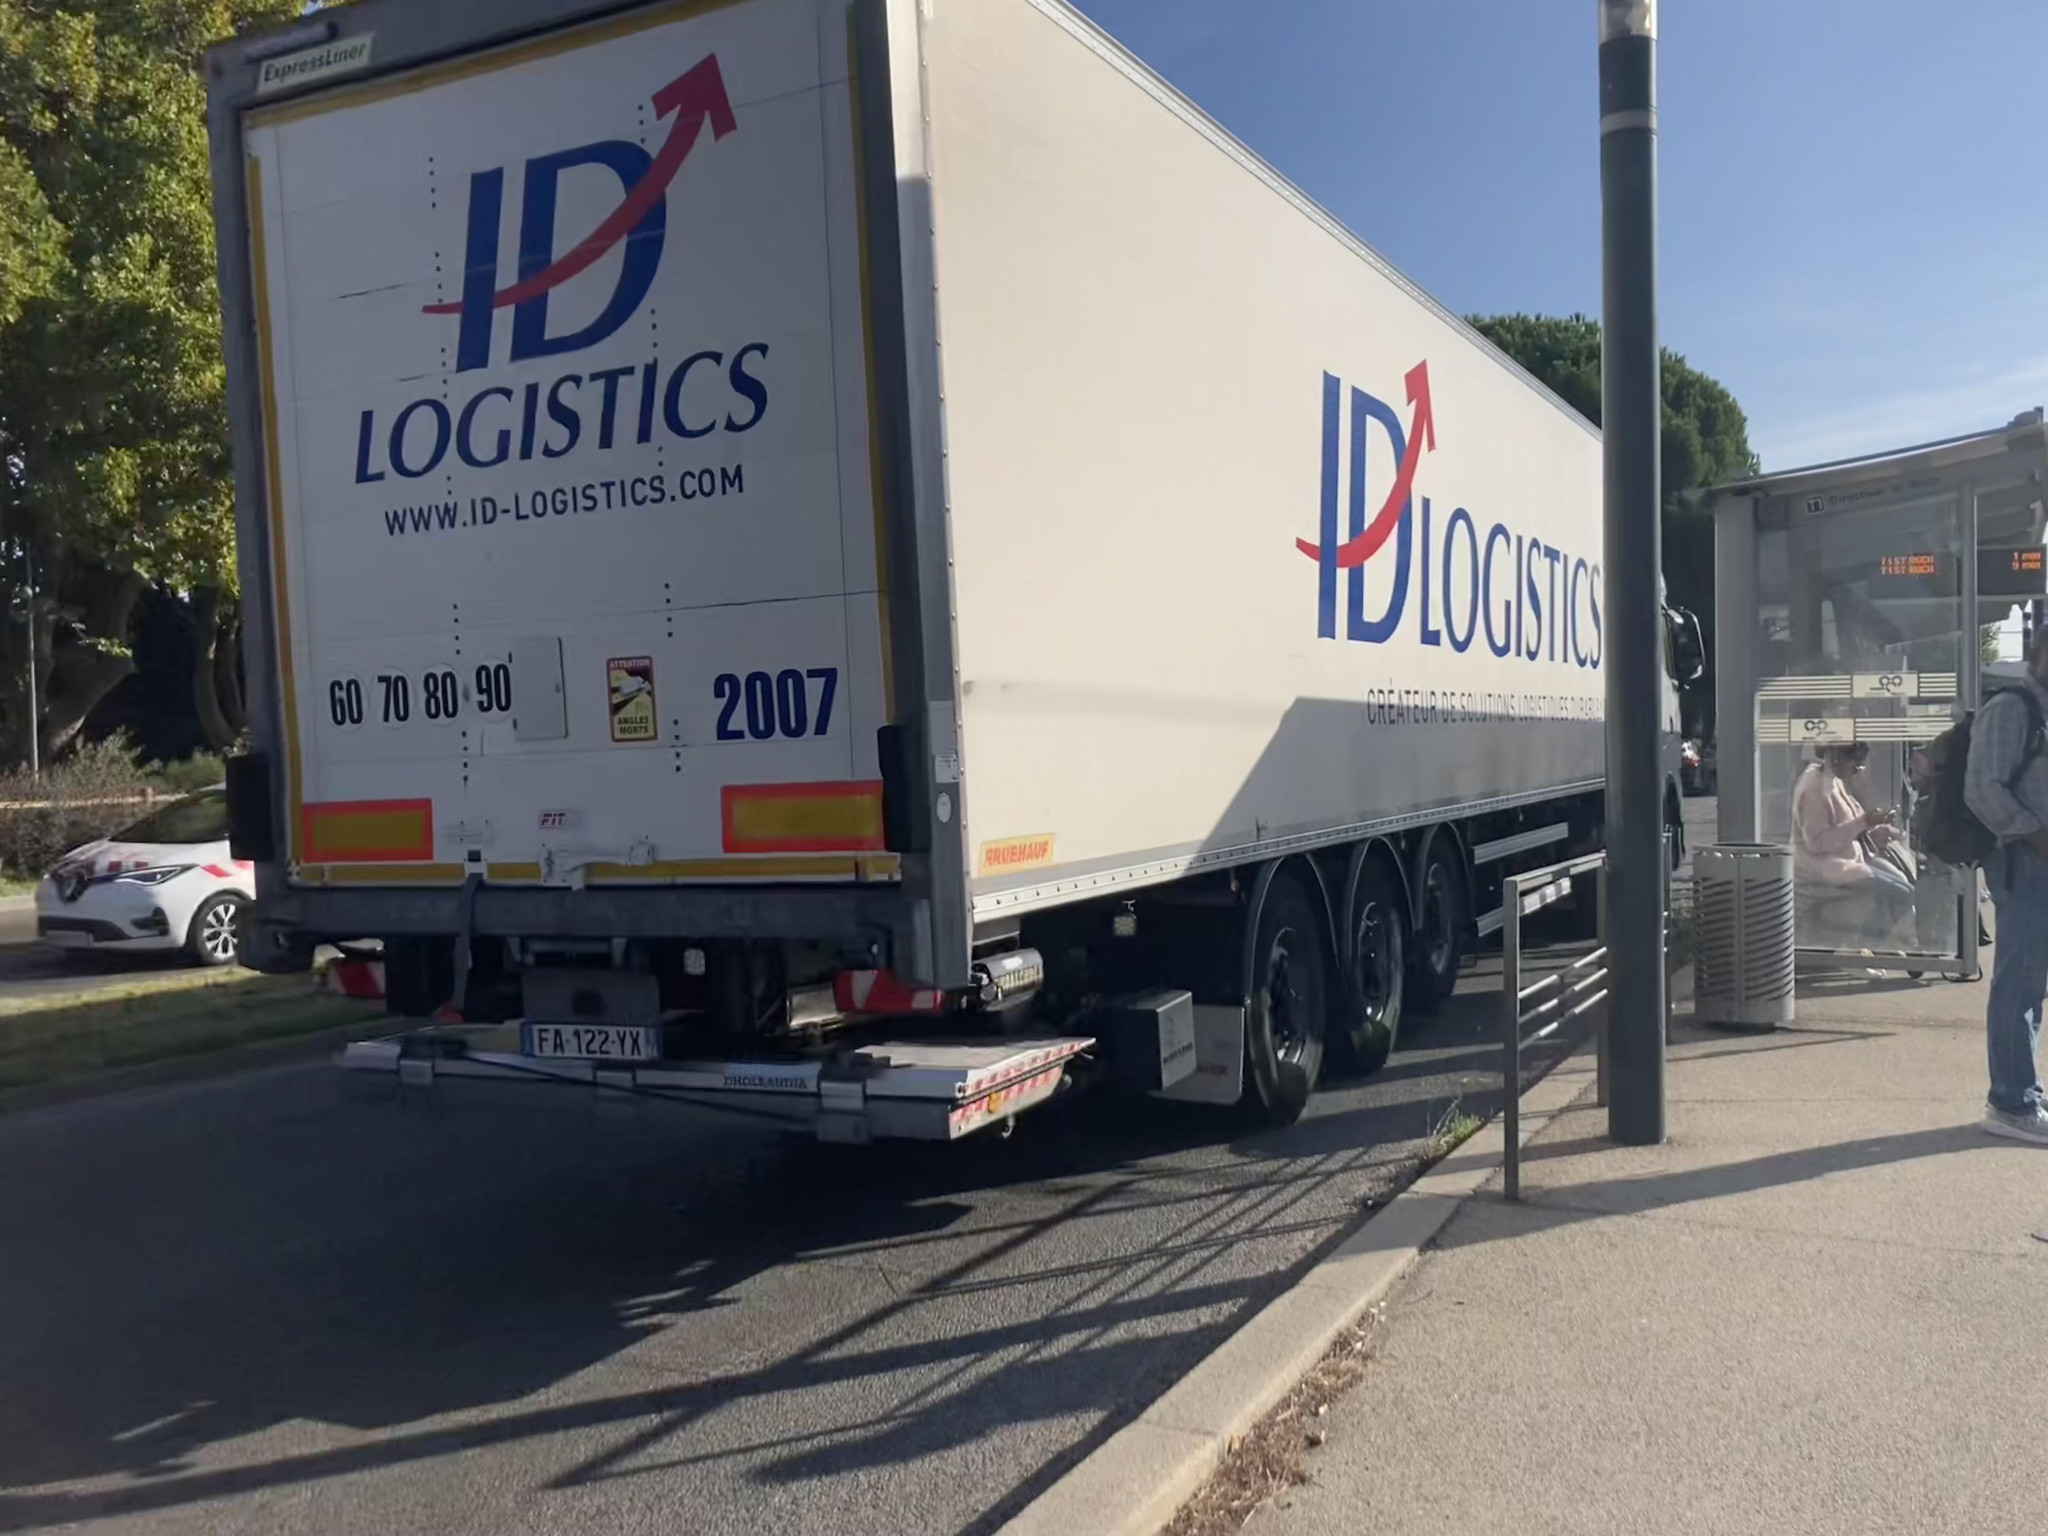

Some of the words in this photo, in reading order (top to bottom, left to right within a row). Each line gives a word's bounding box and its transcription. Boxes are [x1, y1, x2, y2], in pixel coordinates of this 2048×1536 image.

[264, 43, 366, 82] ExpressLiner
[456, 140, 666, 373] ID
[355, 343, 769, 484] LOGISTICS
[384, 464, 745, 535] WWW.ID-LOGISTICS.COM
[1317, 369, 1412, 643] ID
[1420, 495, 1601, 669] LOGISTICS
[609, 658, 651, 669] ATTENTION
[329, 679, 363, 726] 60
[377, 675, 410, 723] 70
[423, 672, 459, 720] 80
[475, 663, 512, 713] 90
[713, 667, 838, 741] 2007
[1441, 690, 1456, 723] DE
[1460, 692, 1515, 722] SOLUTIONS
[617, 715, 649, 725] ANGLES
[619, 725, 649, 735] MORTS
